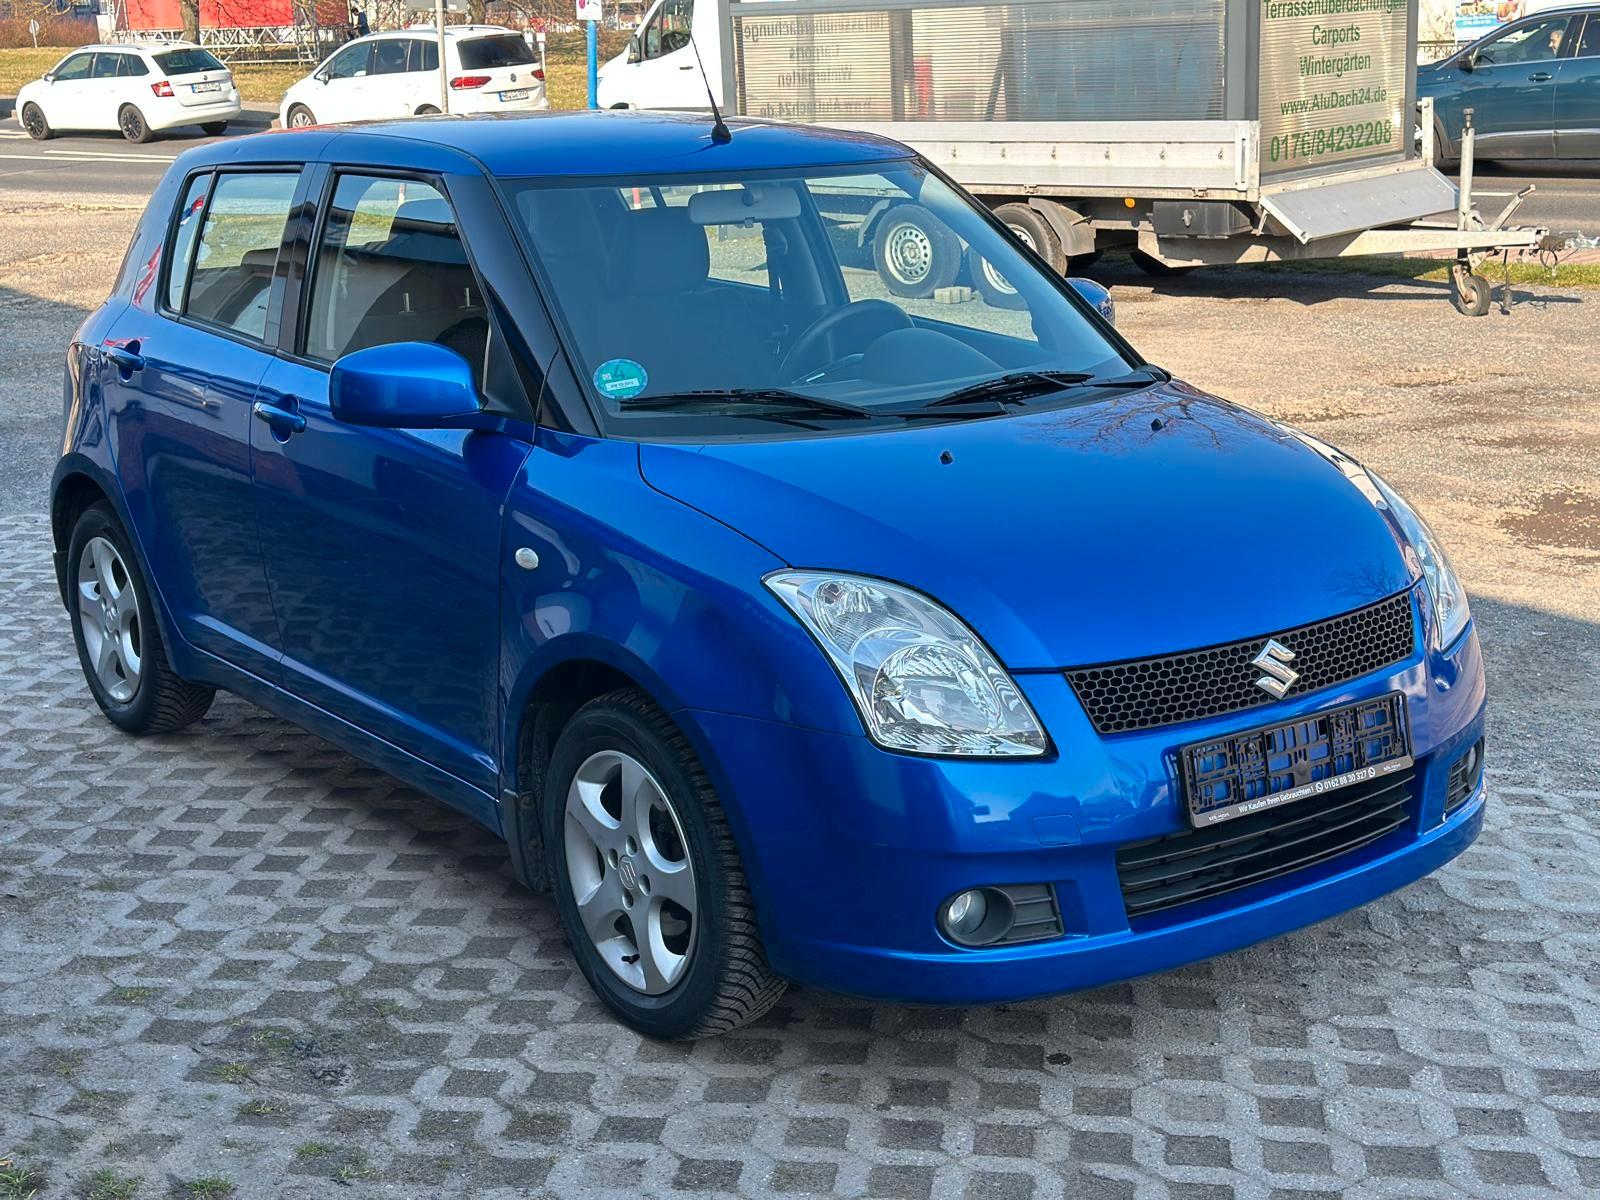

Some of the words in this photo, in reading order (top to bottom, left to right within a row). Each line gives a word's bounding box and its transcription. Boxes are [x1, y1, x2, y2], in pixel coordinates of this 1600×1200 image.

[1312, 24, 1360, 48] Carports
[1299, 52, 1371, 77] Wintergärten
[1280, 87, 1387, 115] www.AluDach24.de
[1270, 120, 1392, 162] 0176/84232208
[1238, 803, 1248, 813] Wir
[1248, 800, 1267, 810] Kaufen
[1324, 778, 1339, 790] 0162
[1339, 775, 1348, 785] 88
[1349, 773, 1356, 783] 30
[1357, 770, 1367, 780] 327
